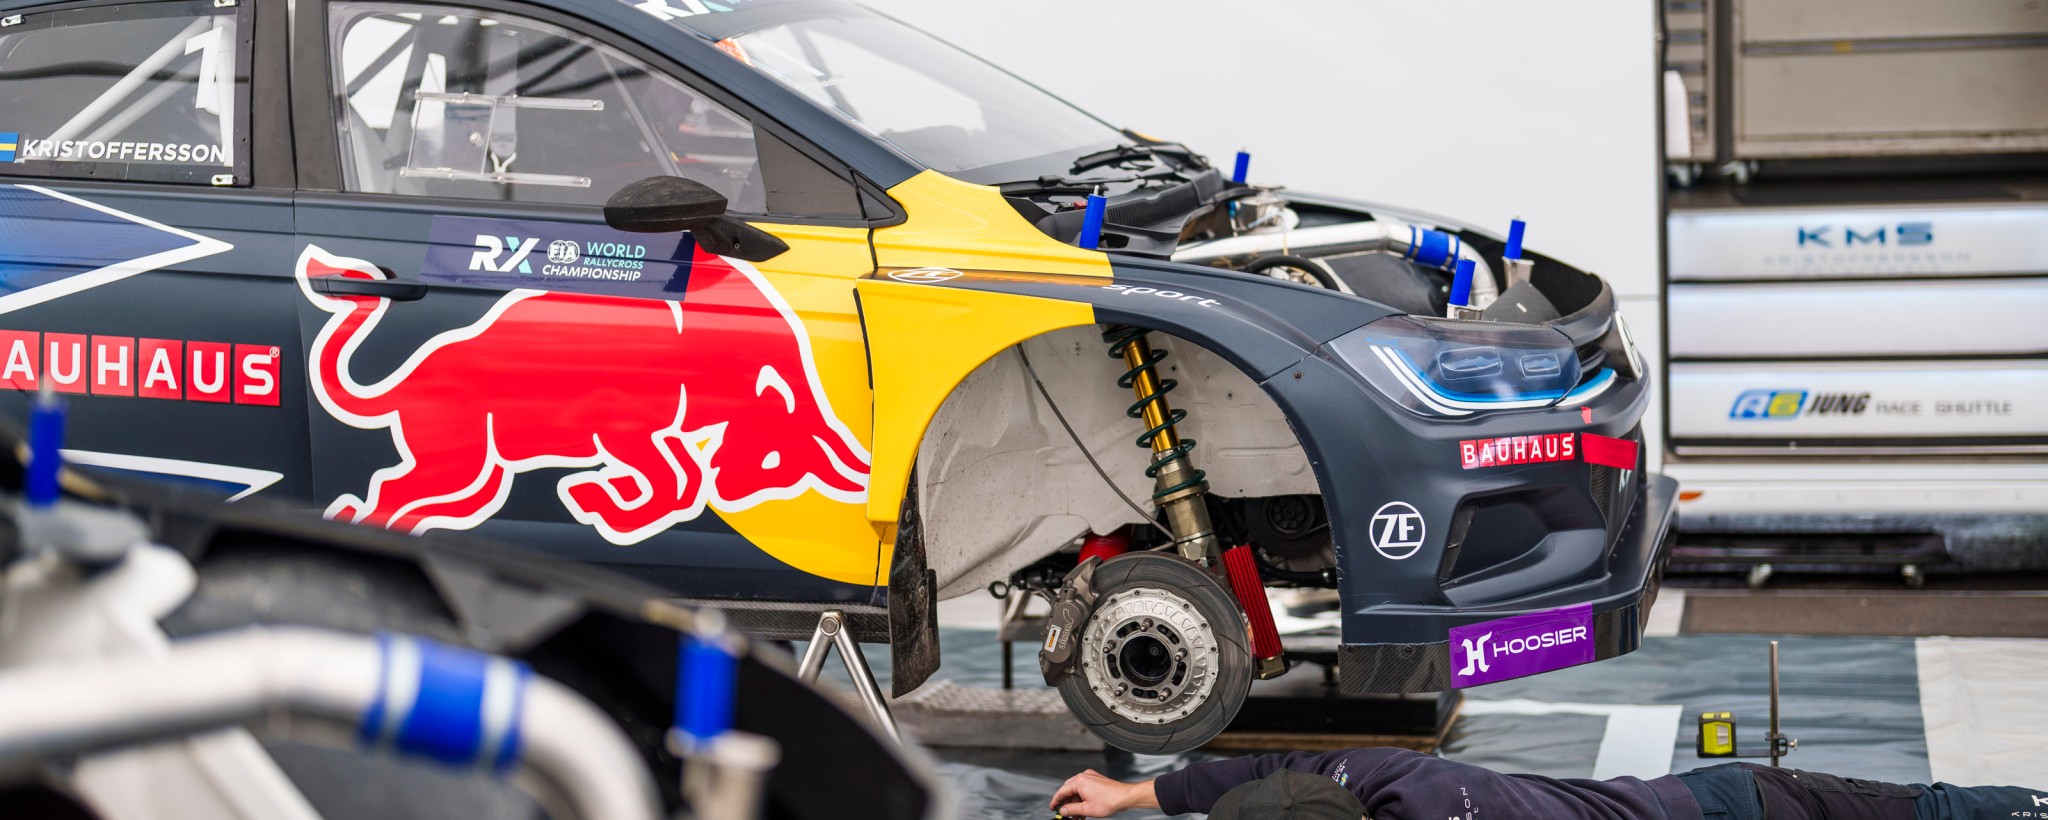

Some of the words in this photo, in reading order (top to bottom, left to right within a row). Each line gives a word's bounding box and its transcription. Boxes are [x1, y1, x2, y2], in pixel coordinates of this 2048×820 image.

[22, 138, 227, 163] KRISTOFFERSSON
[1798, 222, 1933, 248] KMS
[468, 234, 540, 274] RX
[587, 241, 646, 259] WORLD
[542, 264, 641, 282] CHAMPIONSHIP
[583, 257, 644, 270] RALLYCROSS
[1102, 283, 1222, 308] sport
[1807, 392, 1871, 416] JUNG
[1876, 399, 1922, 416] RACE
[1935, 399, 2013, 416] SHUTTLE
[1462, 436, 1574, 464] BAUHAUS
[1371, 509, 1423, 551] ZF
[1492, 625, 1587, 658] HOOSIER
